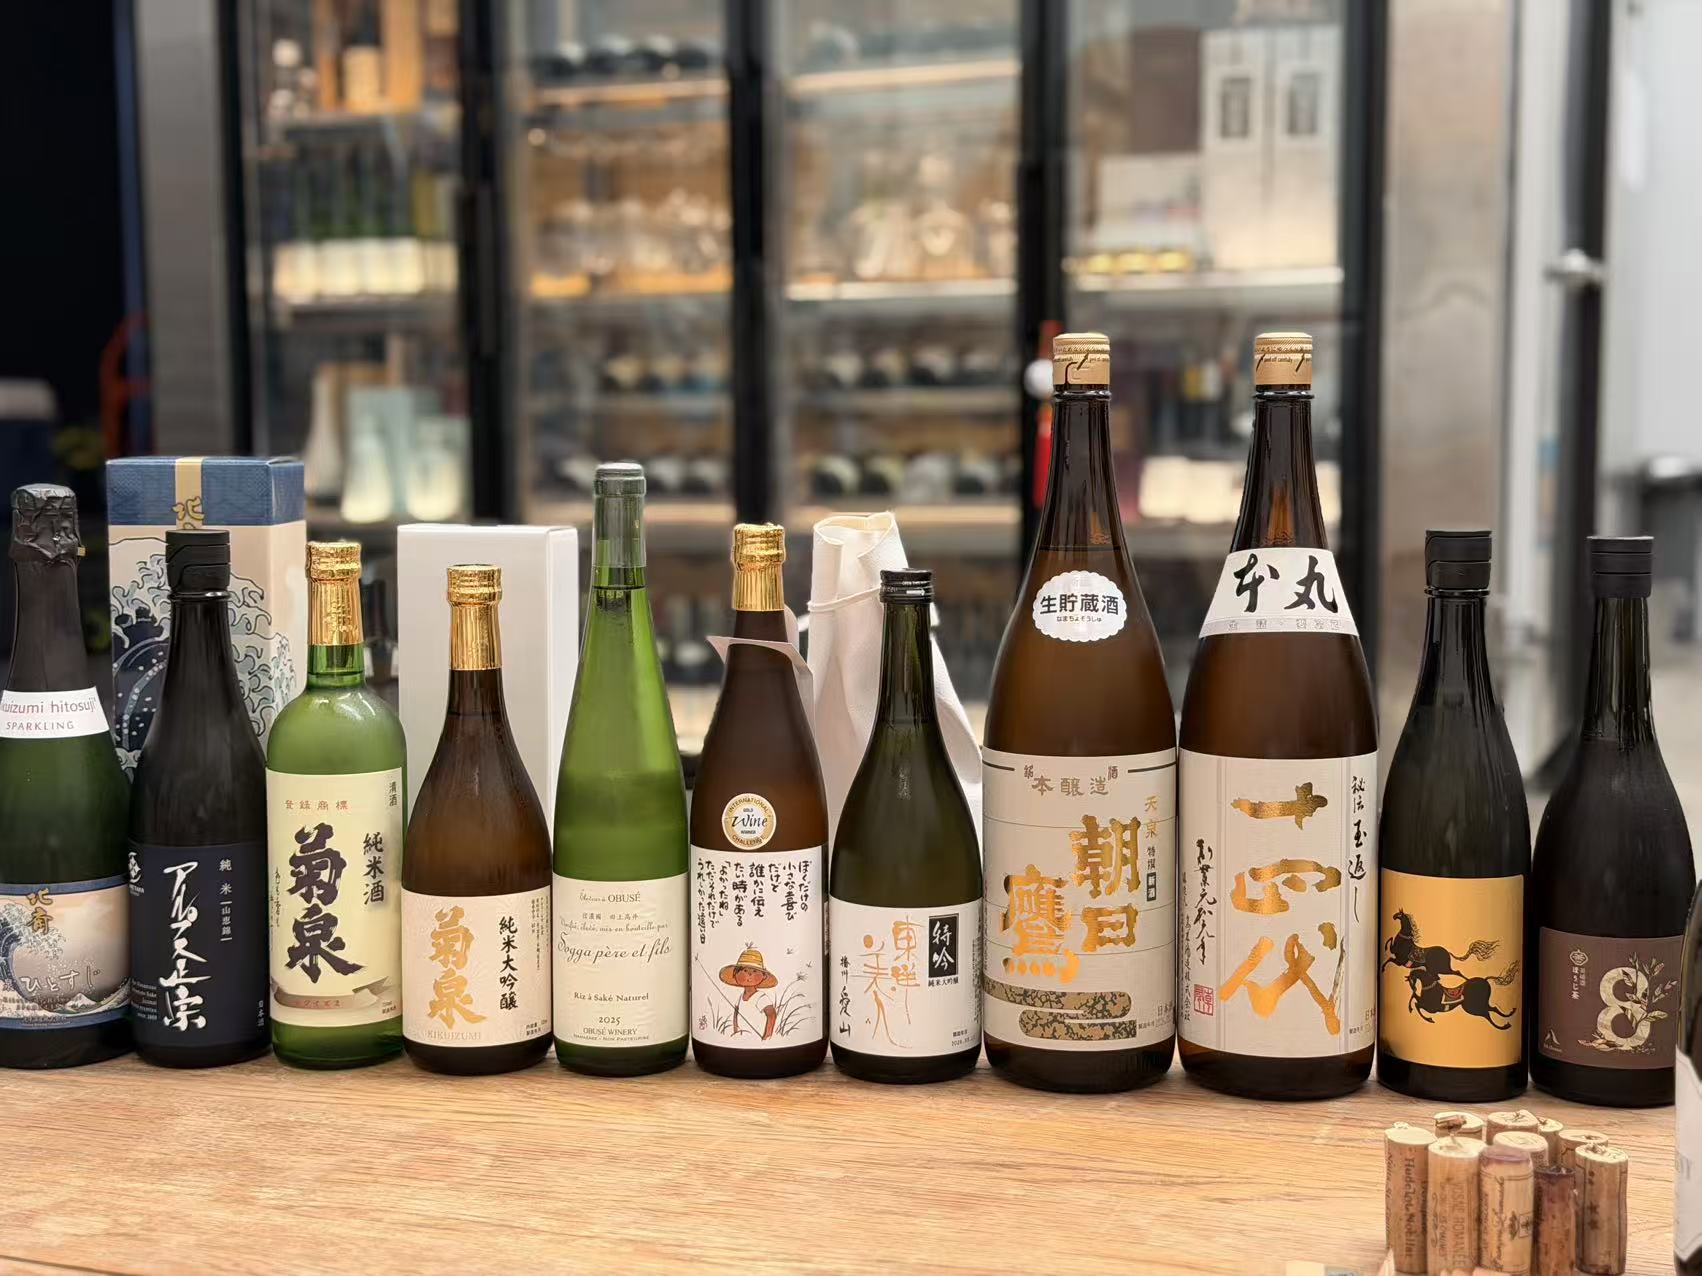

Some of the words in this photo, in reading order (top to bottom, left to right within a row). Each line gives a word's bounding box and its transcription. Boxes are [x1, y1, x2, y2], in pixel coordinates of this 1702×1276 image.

[1233, 553, 1339, 613] 本丸
[1040, 593, 1119, 615] 生貯蔵酒
[51, 697, 96, 713] hitosuji
[6, 721, 75, 731] SPARKLING
[1031, 775, 1109, 796] 本醸造
[728, 797, 769, 814] INTERNATIONAL
[730, 814, 768, 827] Wine
[219, 859, 232, 895] 純米
[363, 831, 384, 906] 純米酒
[768, 862, 782, 893] だけど
[284, 822, 368, 984] 菊泉
[607, 891, 641, 903] OBUSÉ
[732, 862, 748, 927] たい時がある
[749, 861, 765, 918] 誰かに伝え
[1217, 781, 1346, 1035] 十四代
[159, 861, 212, 1031] アルプス正宗
[557, 932, 591, 963] Sogga
[592, 945, 630, 964] père
[631, 944, 647, 958] et
[647, 937, 672, 962] fils
[932, 920, 955, 971] 特吟
[427, 905, 487, 1029] 菊泉
[499, 916, 518, 1011] 純米大吟醸
[594, 993, 613, 1002] Saké
[616, 993, 649, 1002] Naturel
[928, 977, 959, 988] 純米大吟醸
[598, 1016, 621, 1026] 2025
[607, 1028, 638, 1036] WINERY
